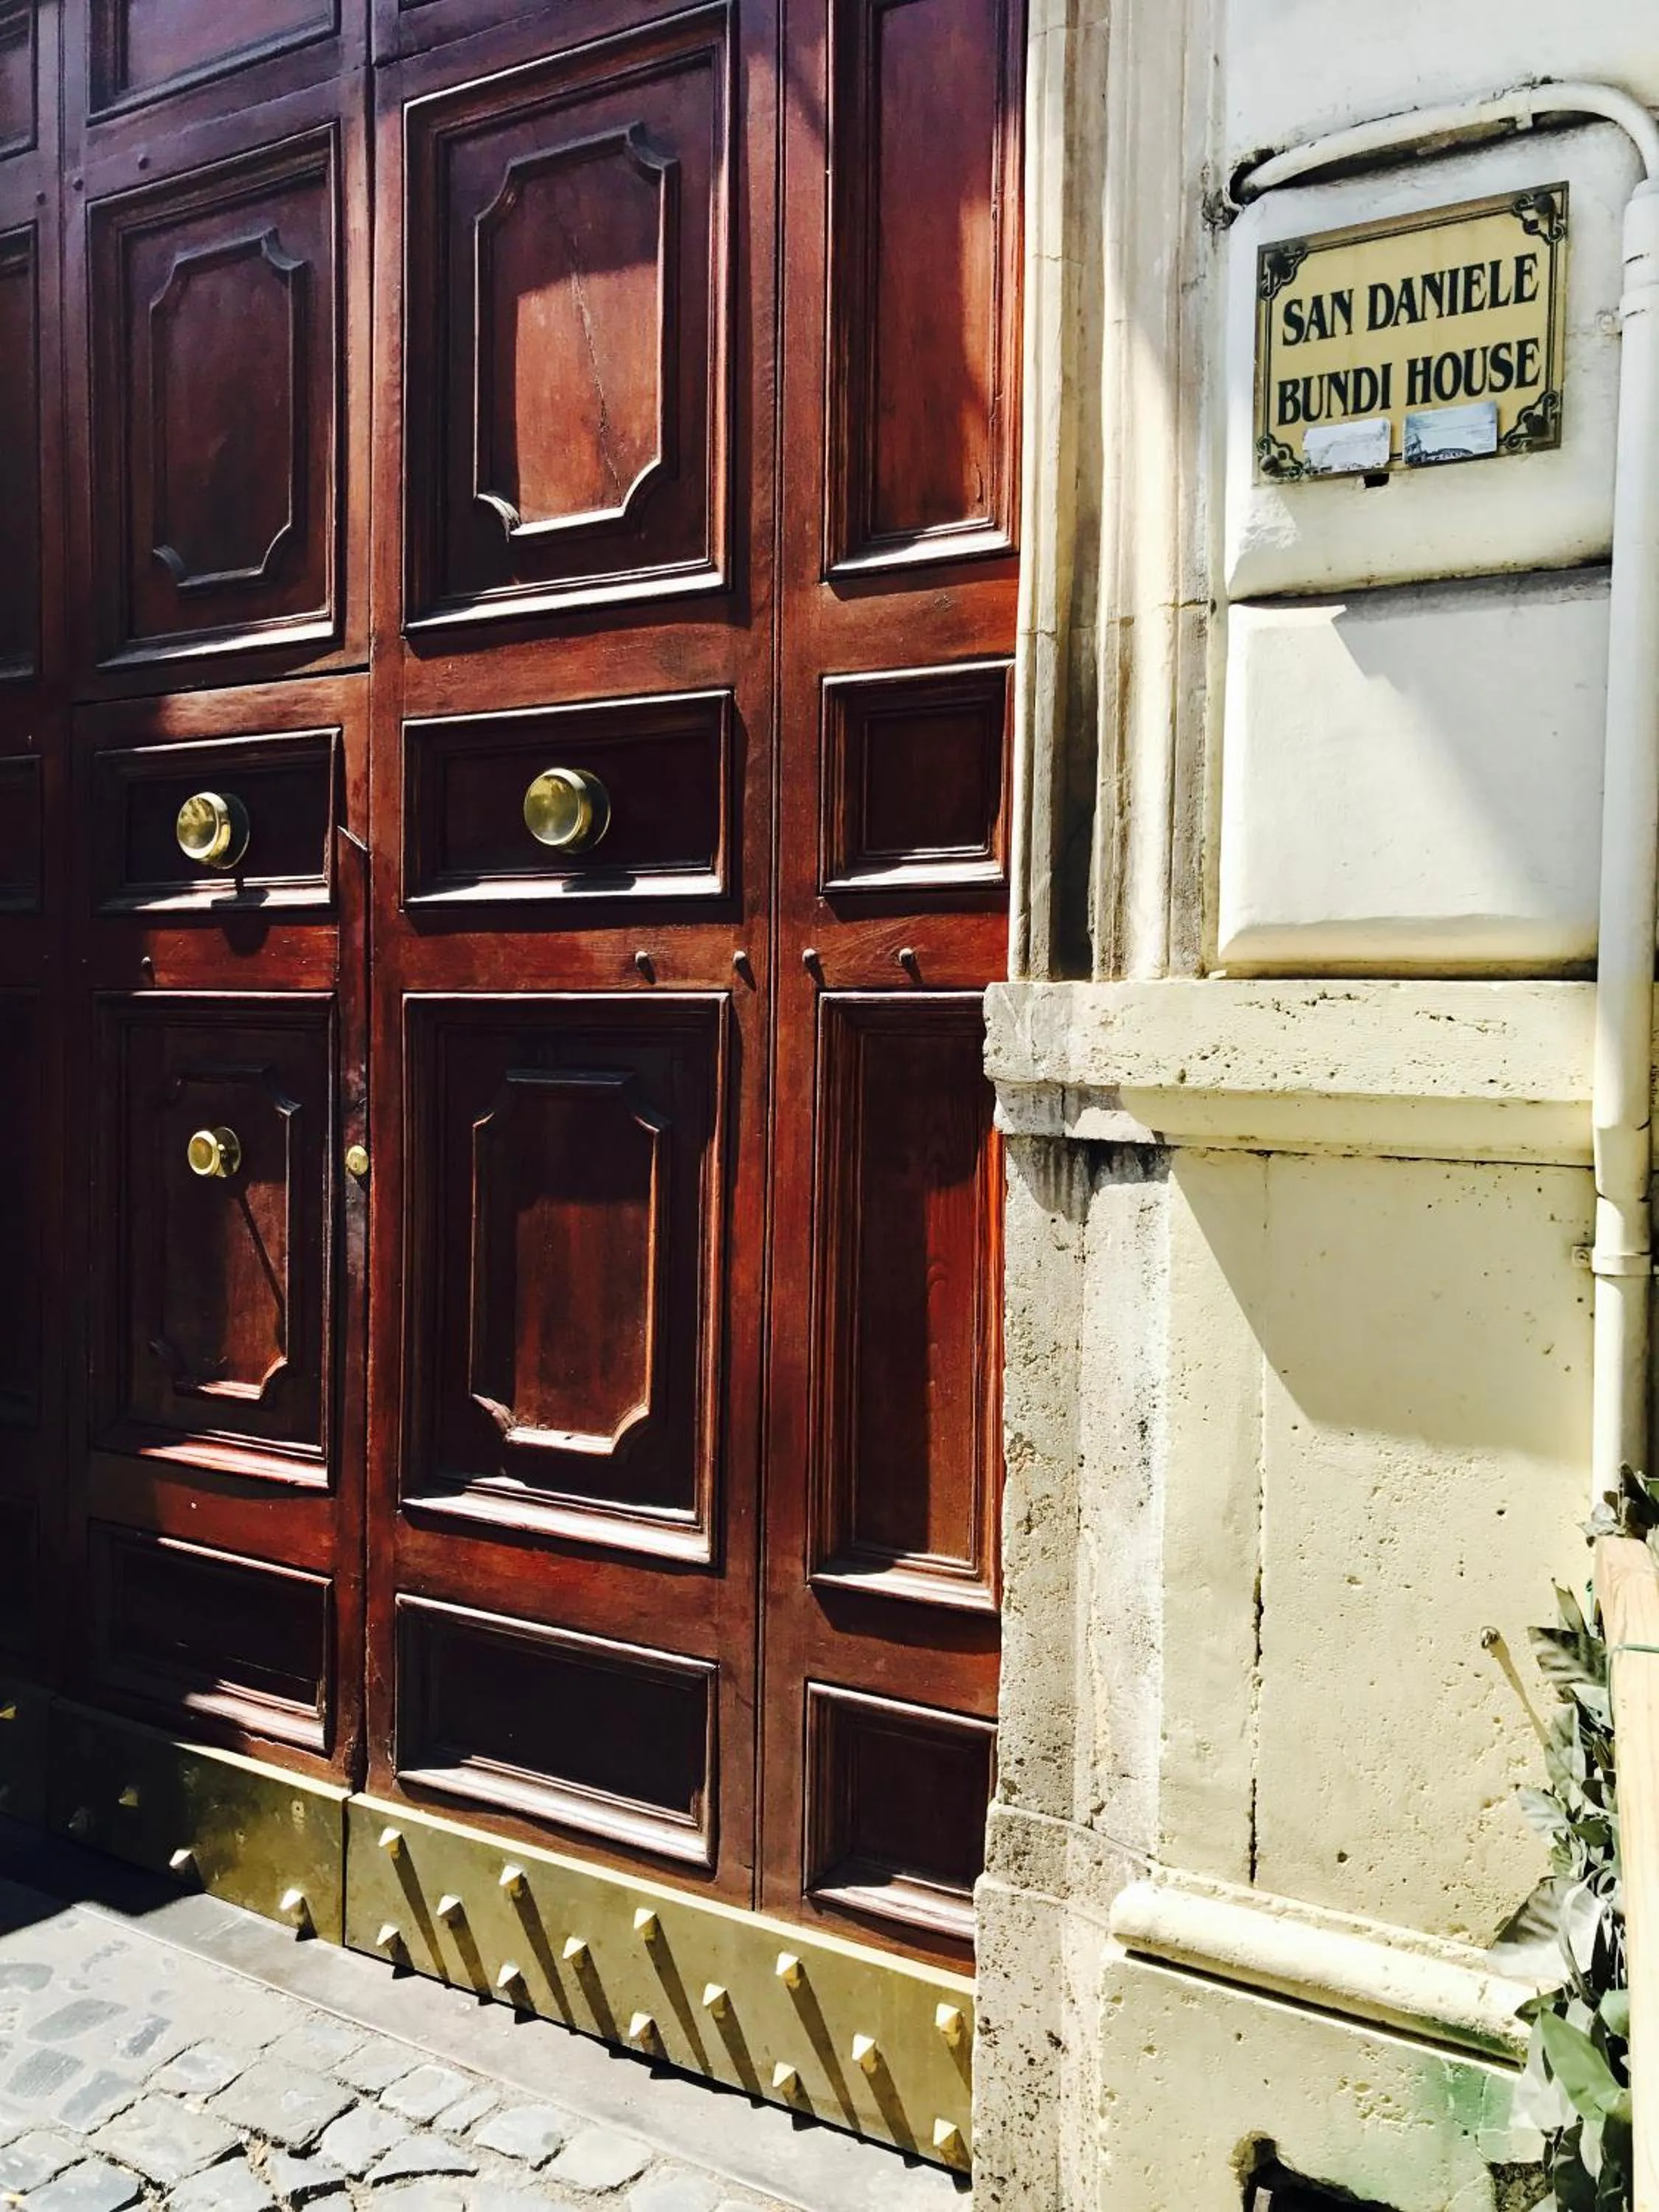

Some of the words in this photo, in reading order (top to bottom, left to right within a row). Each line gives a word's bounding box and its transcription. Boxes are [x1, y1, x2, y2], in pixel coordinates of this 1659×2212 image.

[1281, 288, 1354, 347] SAN
[1366, 252, 1540, 332] DANIELE
[1277, 362, 1393, 426] BUNDI
[1405, 337, 1541, 406] HOUSE
